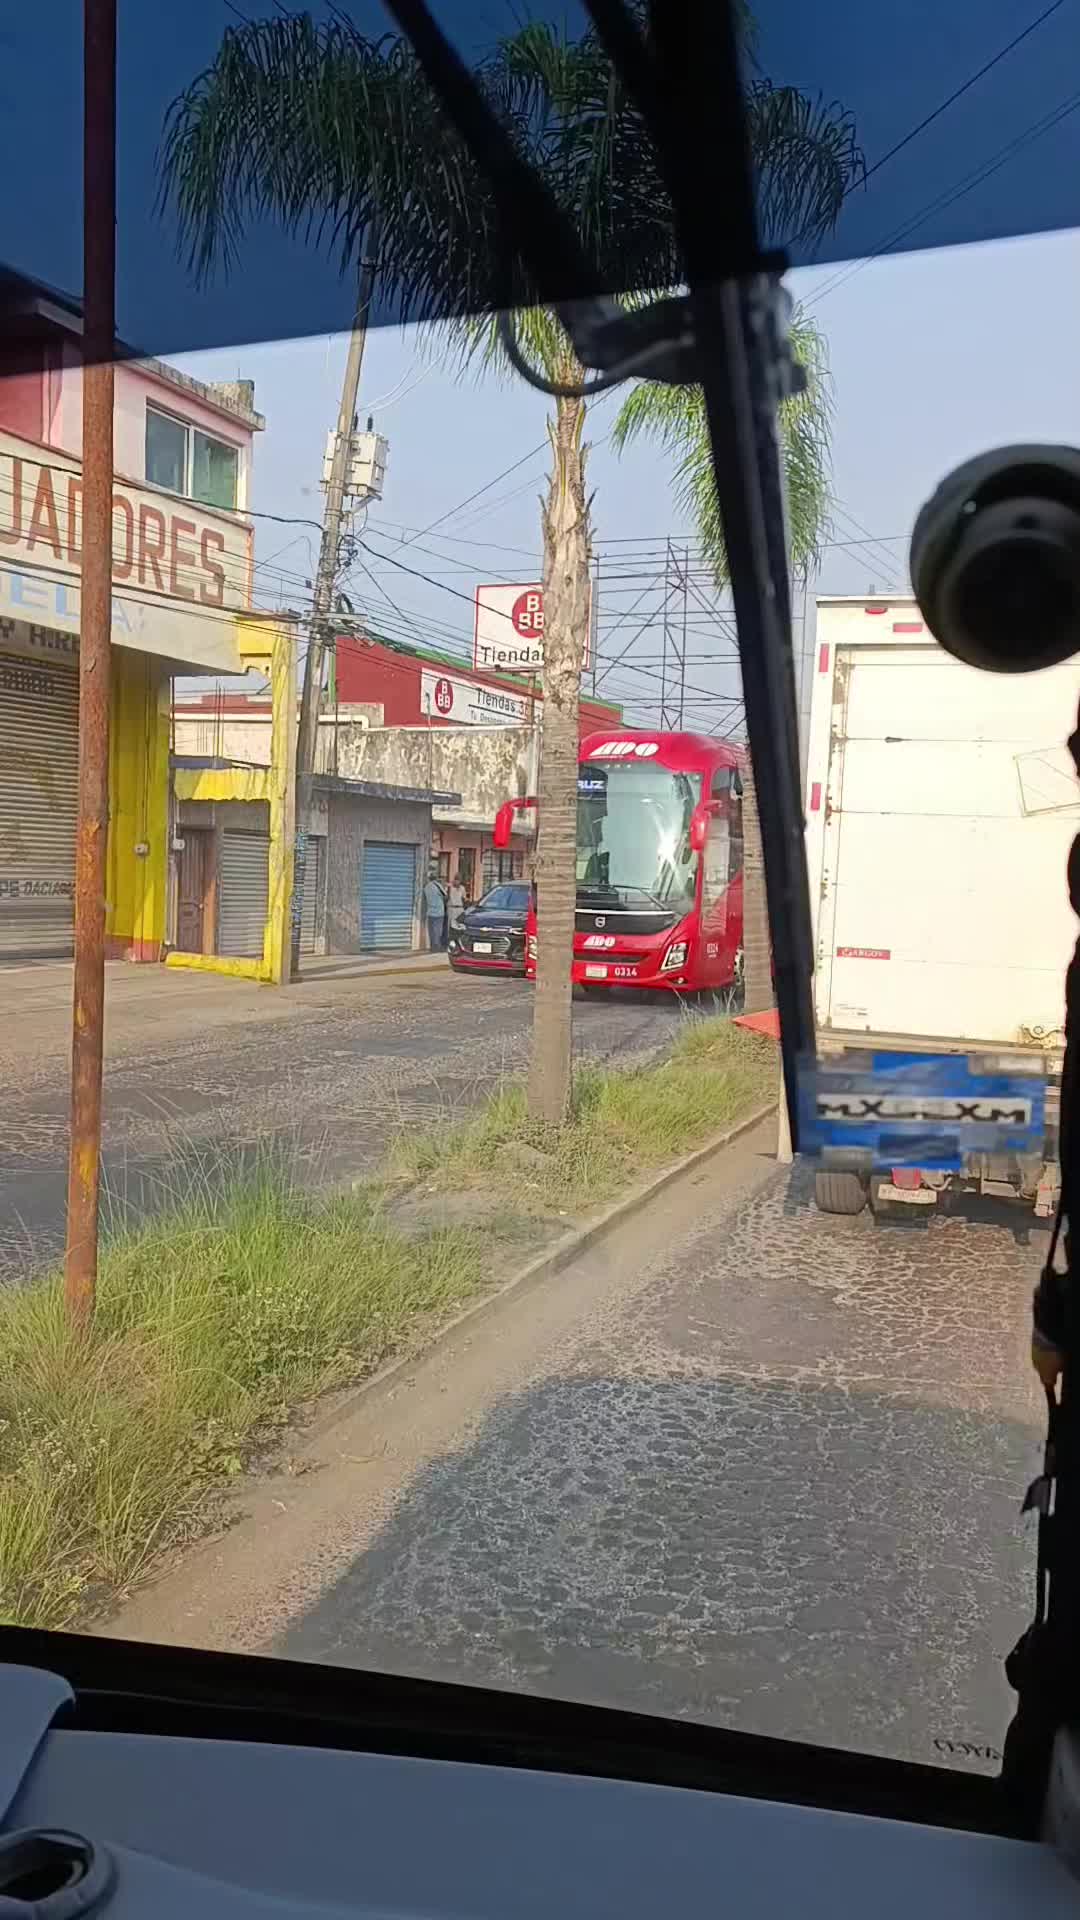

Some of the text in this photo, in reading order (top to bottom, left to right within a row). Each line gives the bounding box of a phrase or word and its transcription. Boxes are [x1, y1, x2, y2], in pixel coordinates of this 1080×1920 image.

[480, 645, 545, 663] Tienda
[477, 688, 516, 713] Tiendas
[589, 741, 660, 757] ADO
[583, 935, 616, 948] ADO
[614, 967, 638, 977] 0314
